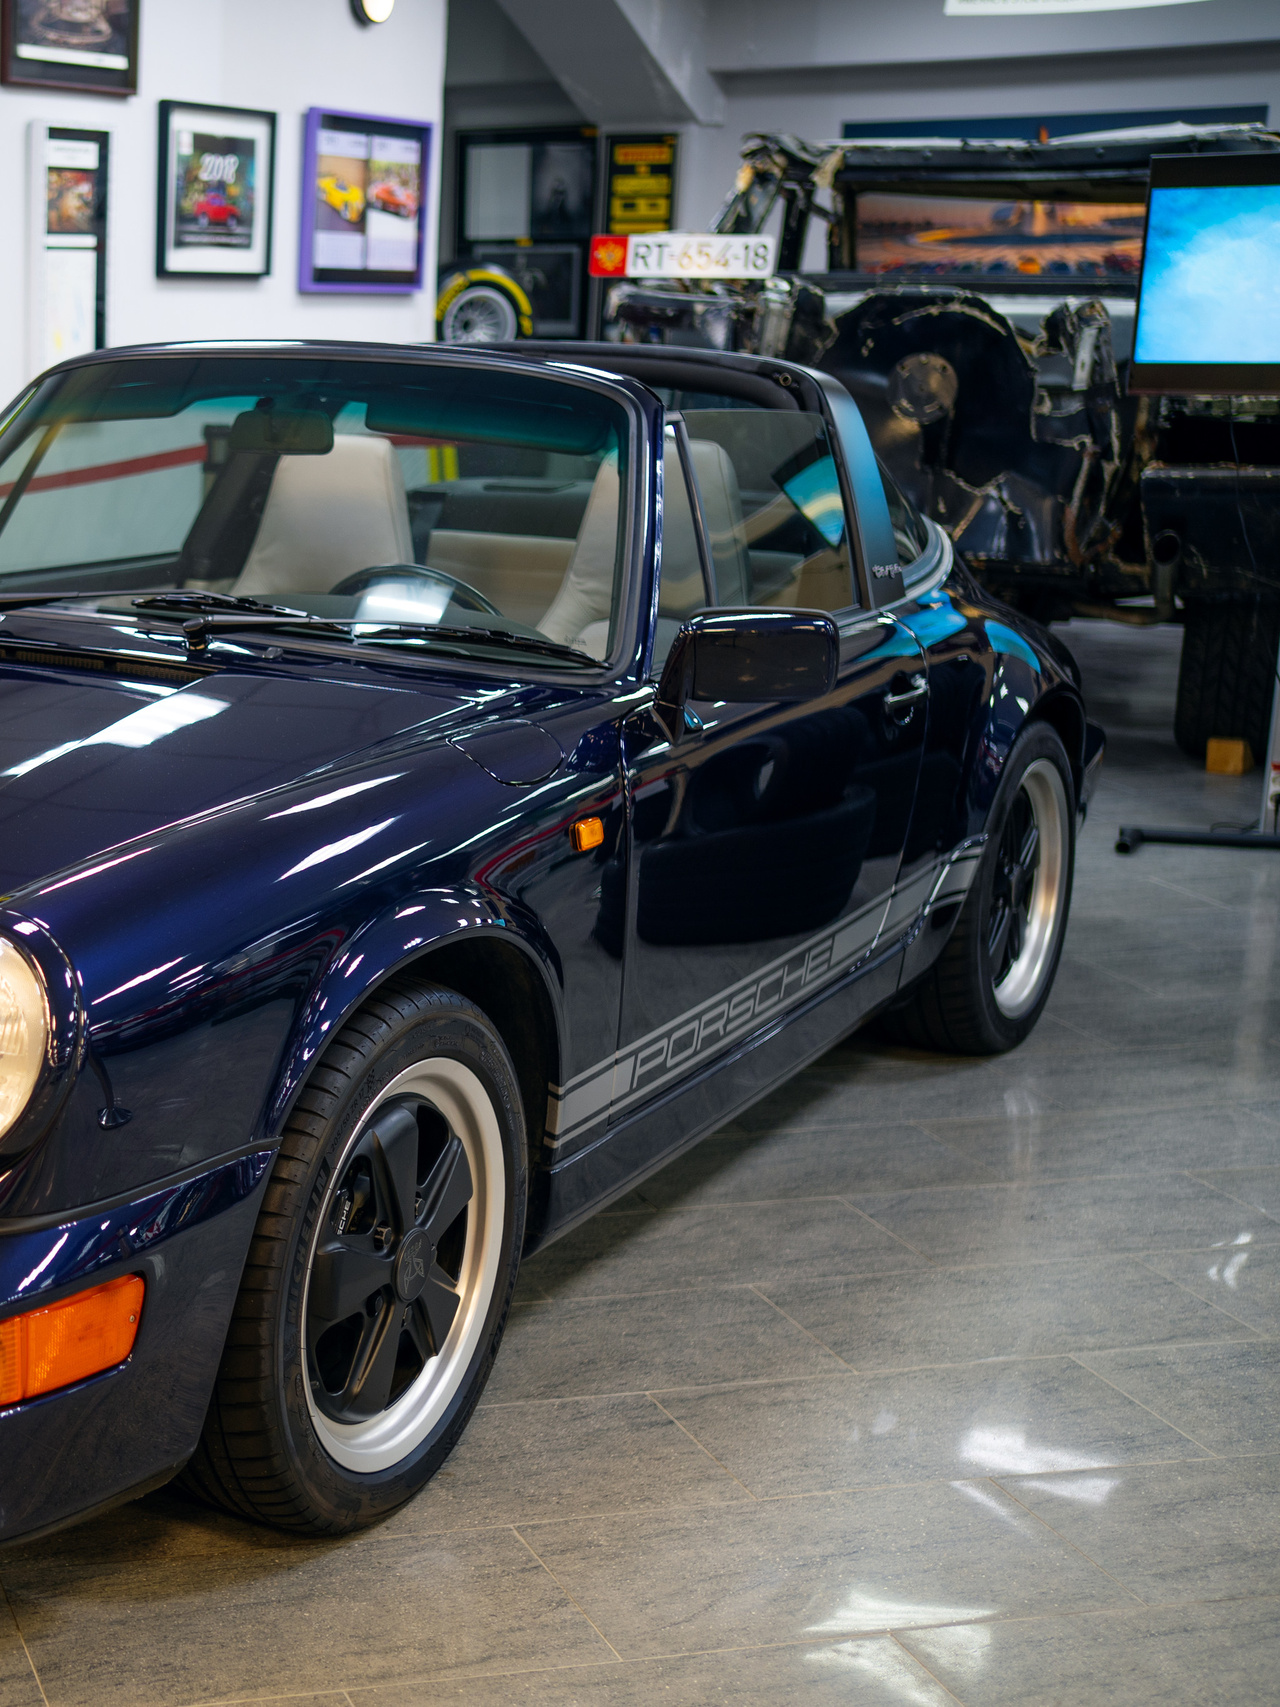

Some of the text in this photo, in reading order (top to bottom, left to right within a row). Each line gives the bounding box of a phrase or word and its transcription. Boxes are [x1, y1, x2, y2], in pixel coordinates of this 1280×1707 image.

[632, 242, 769, 271] RT-654-18
[632, 937, 835, 1089] PORSCHE
[286, 1169, 327, 1323] MICHELIN
